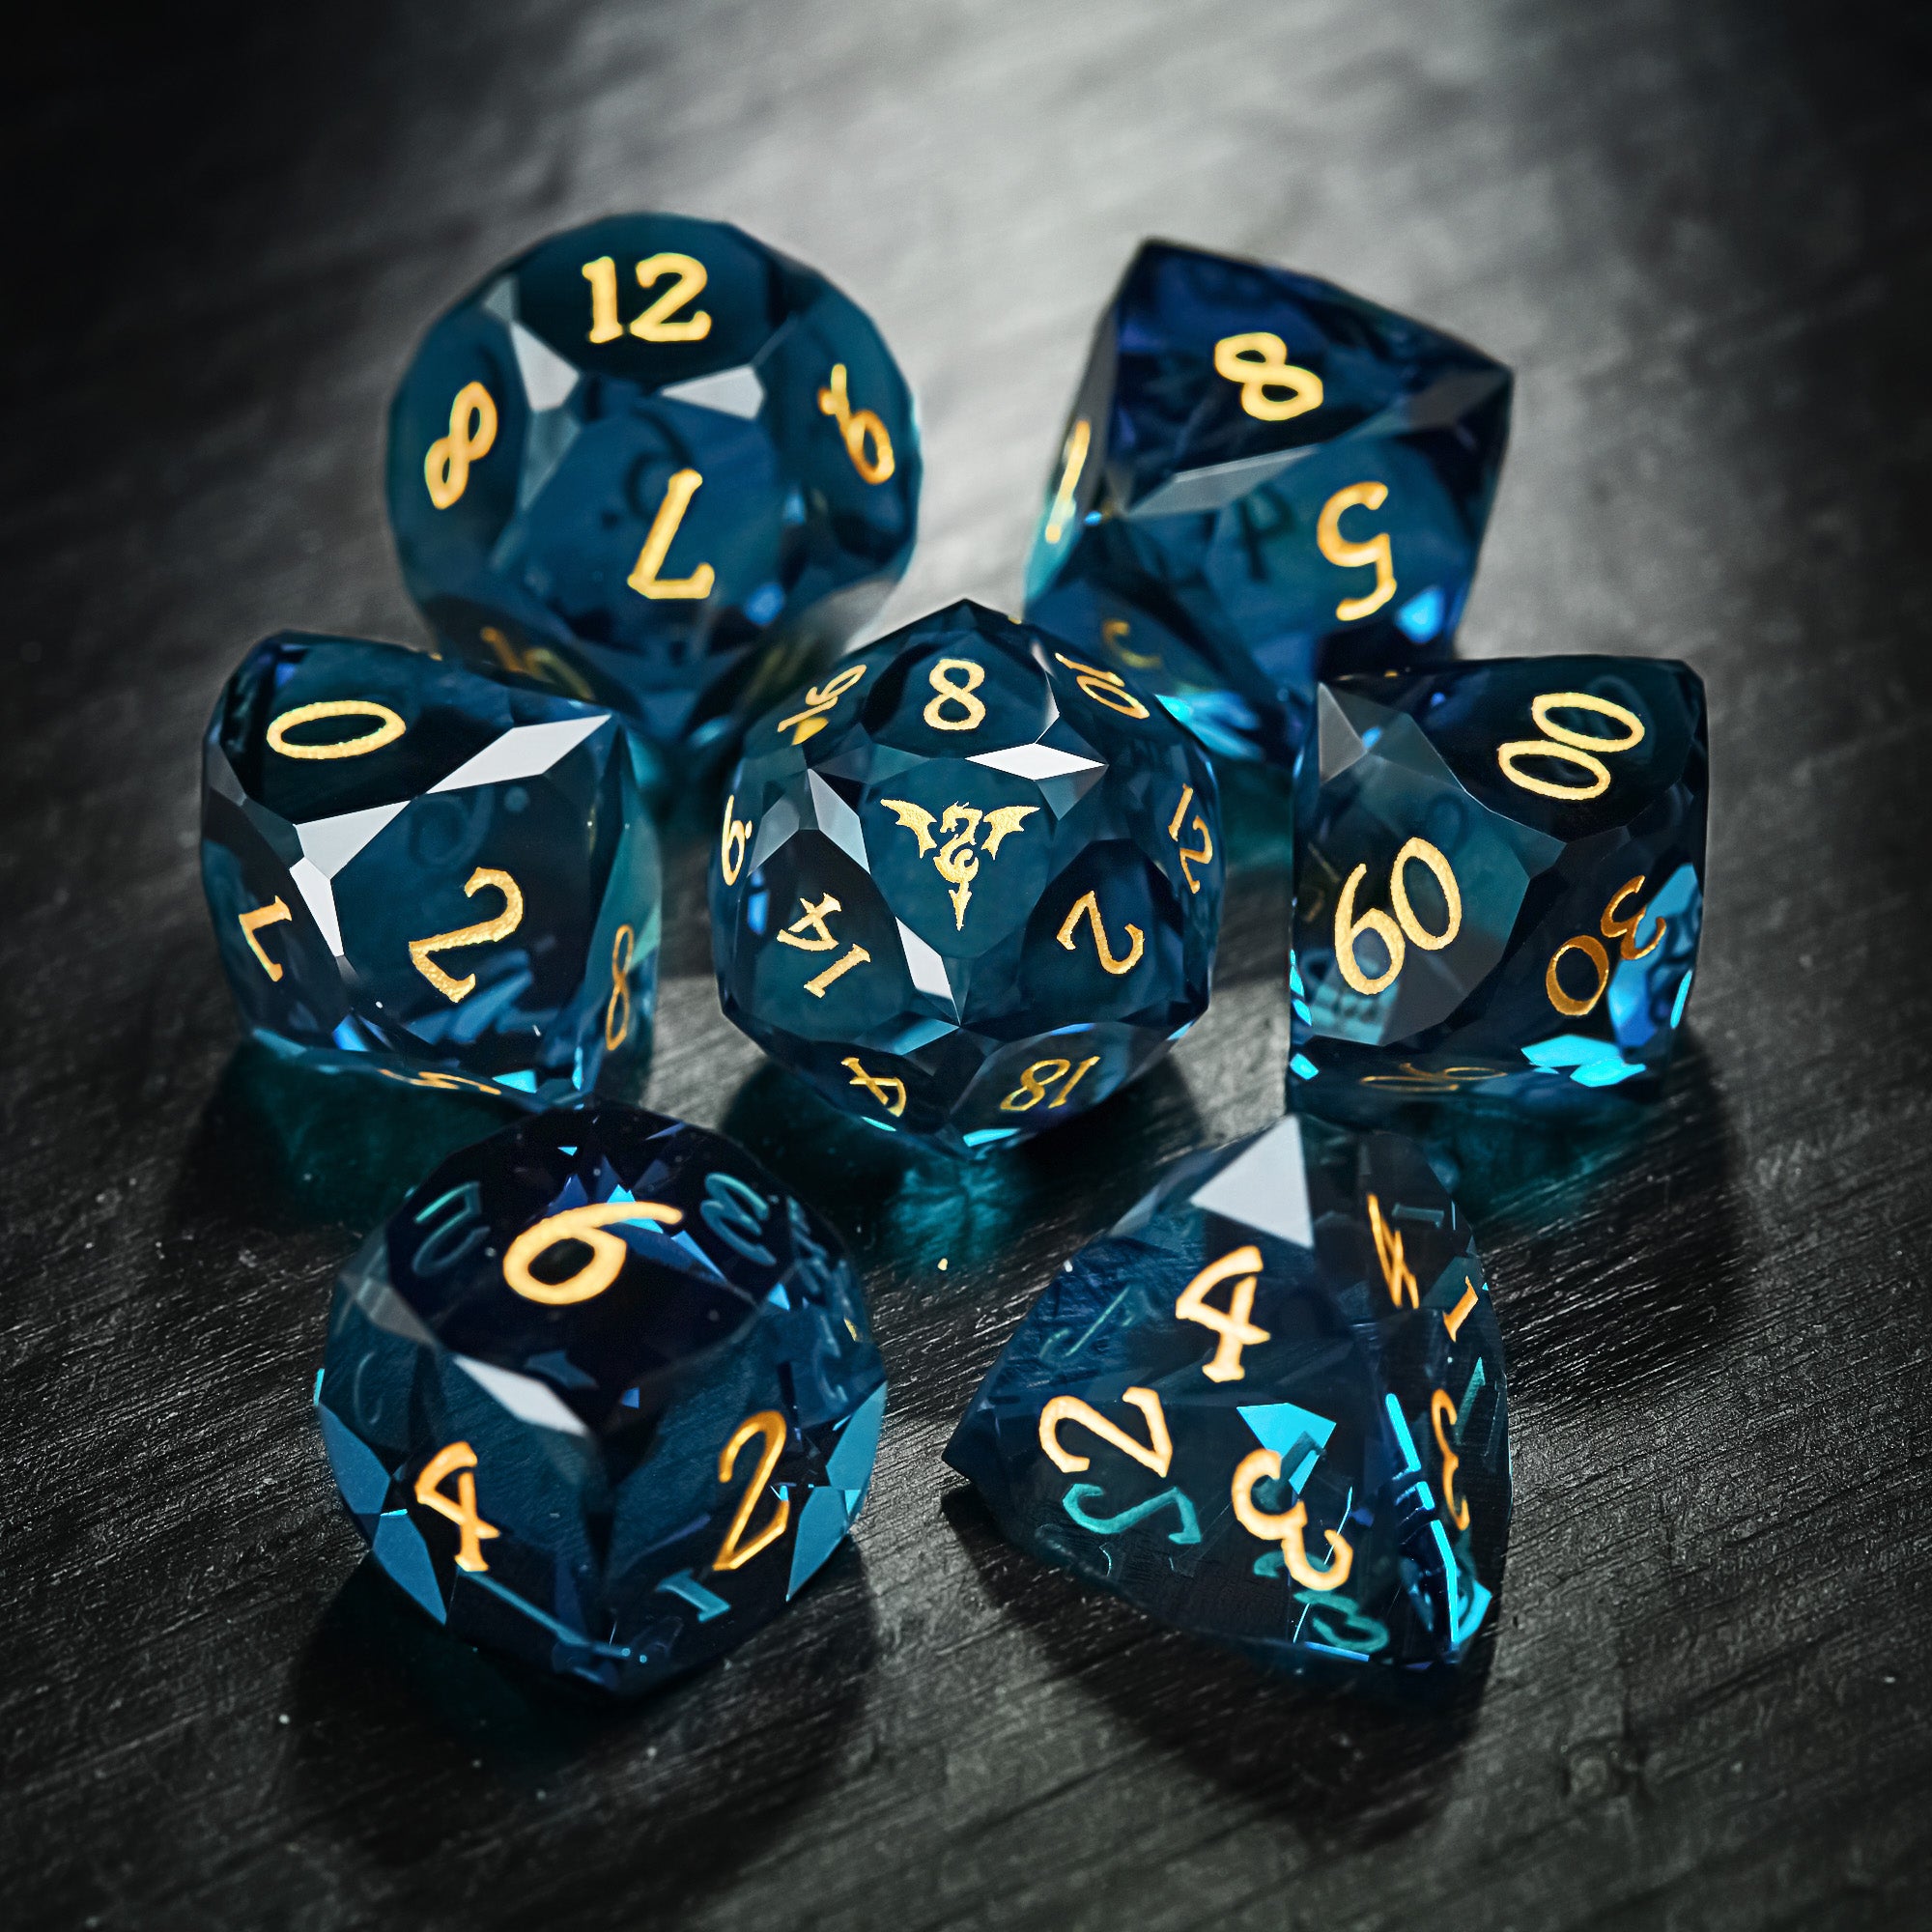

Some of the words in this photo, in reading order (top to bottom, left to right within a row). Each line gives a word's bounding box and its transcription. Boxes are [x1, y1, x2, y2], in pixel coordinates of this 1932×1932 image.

[582, 253, 715, 344] 12
[1213, 332, 1324, 422] 8
[425, 381, 498, 510] 8
[627, 469, 716, 601] 7
[1317, 481, 1397, 621] 5
[267, 700, 407, 760] 0
[923, 659, 986, 730] 8
[1055, 653, 1150, 720] 10
[1497, 693, 1645, 801] 00
[1167, 783, 1214, 895] 12
[409, 867, 524, 1003] 2
[778, 894, 871, 999] 14
[1056, 890, 1145, 975] 2
[1334, 837, 1463, 995] 60
[1545, 874, 1666, 1016] 30
[606, 924, 634, 1051] 8
[841, 1057, 907, 1118] 4
[999, 1056, 1100, 1112] 18
[502, 1200, 683, 1306] 6
[1176, 1244, 1271, 1383] 4
[1038, 1386, 1174, 1478] 2
[1431, 1387, 1471, 1532] 3
[413, 1440, 499, 1572] 4
[712, 1410, 791, 1572] 2
[1231, 1447, 1354, 1590] 3
